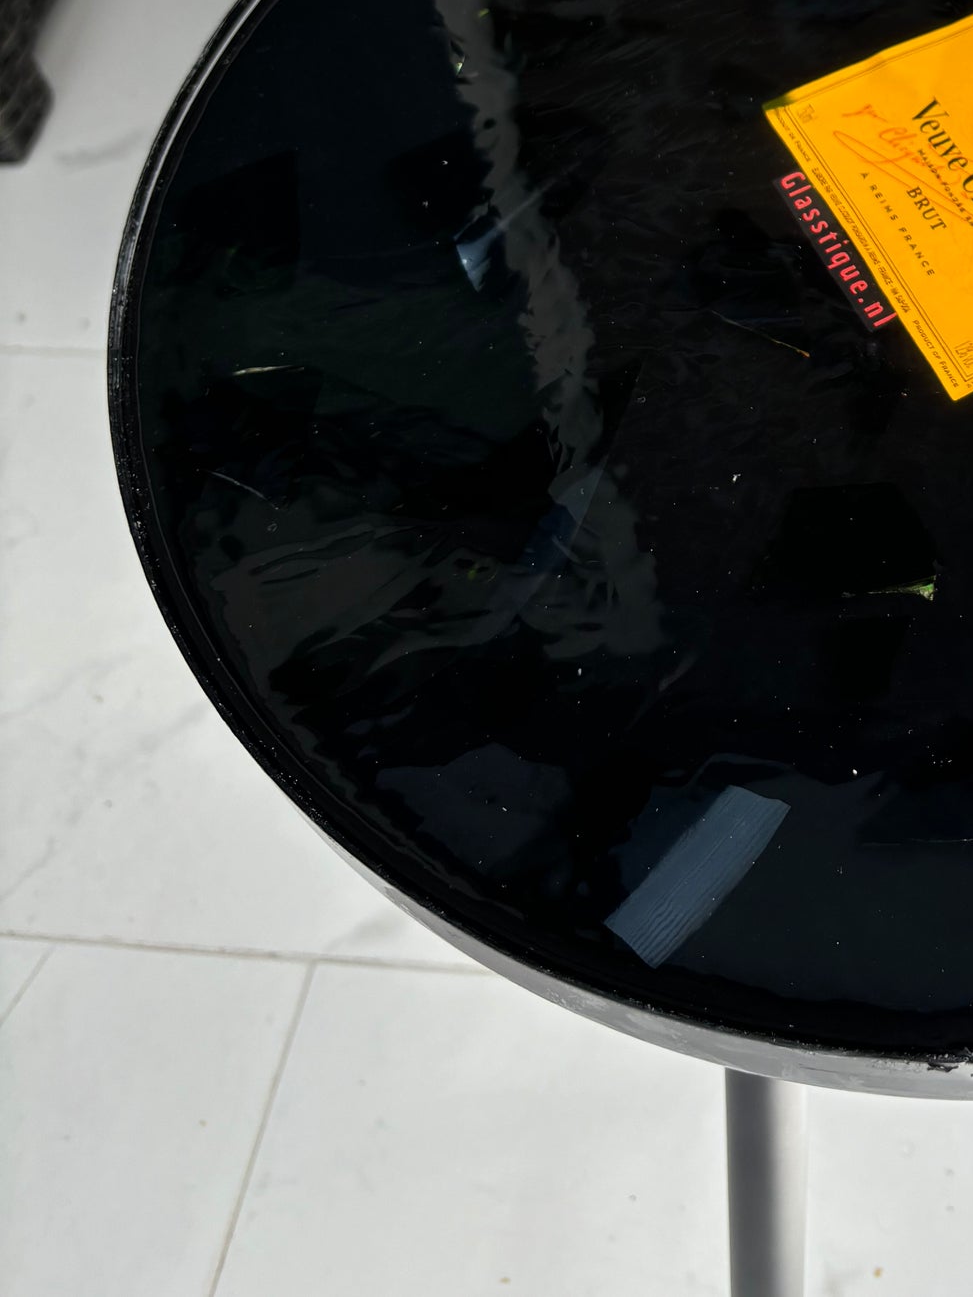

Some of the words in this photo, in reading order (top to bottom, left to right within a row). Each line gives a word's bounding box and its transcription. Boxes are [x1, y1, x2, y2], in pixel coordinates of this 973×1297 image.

[912, 96, 968, 172] Veuve
[869, 184, 899, 221] REIMS
[898, 227, 936, 277] FRANCE
[906, 185, 948, 231] BRUT
[780, 171, 898, 328] Glasstique.nl
[913, 319, 935, 350] PRODUCT
[940, 360, 960, 388] FRANCE
